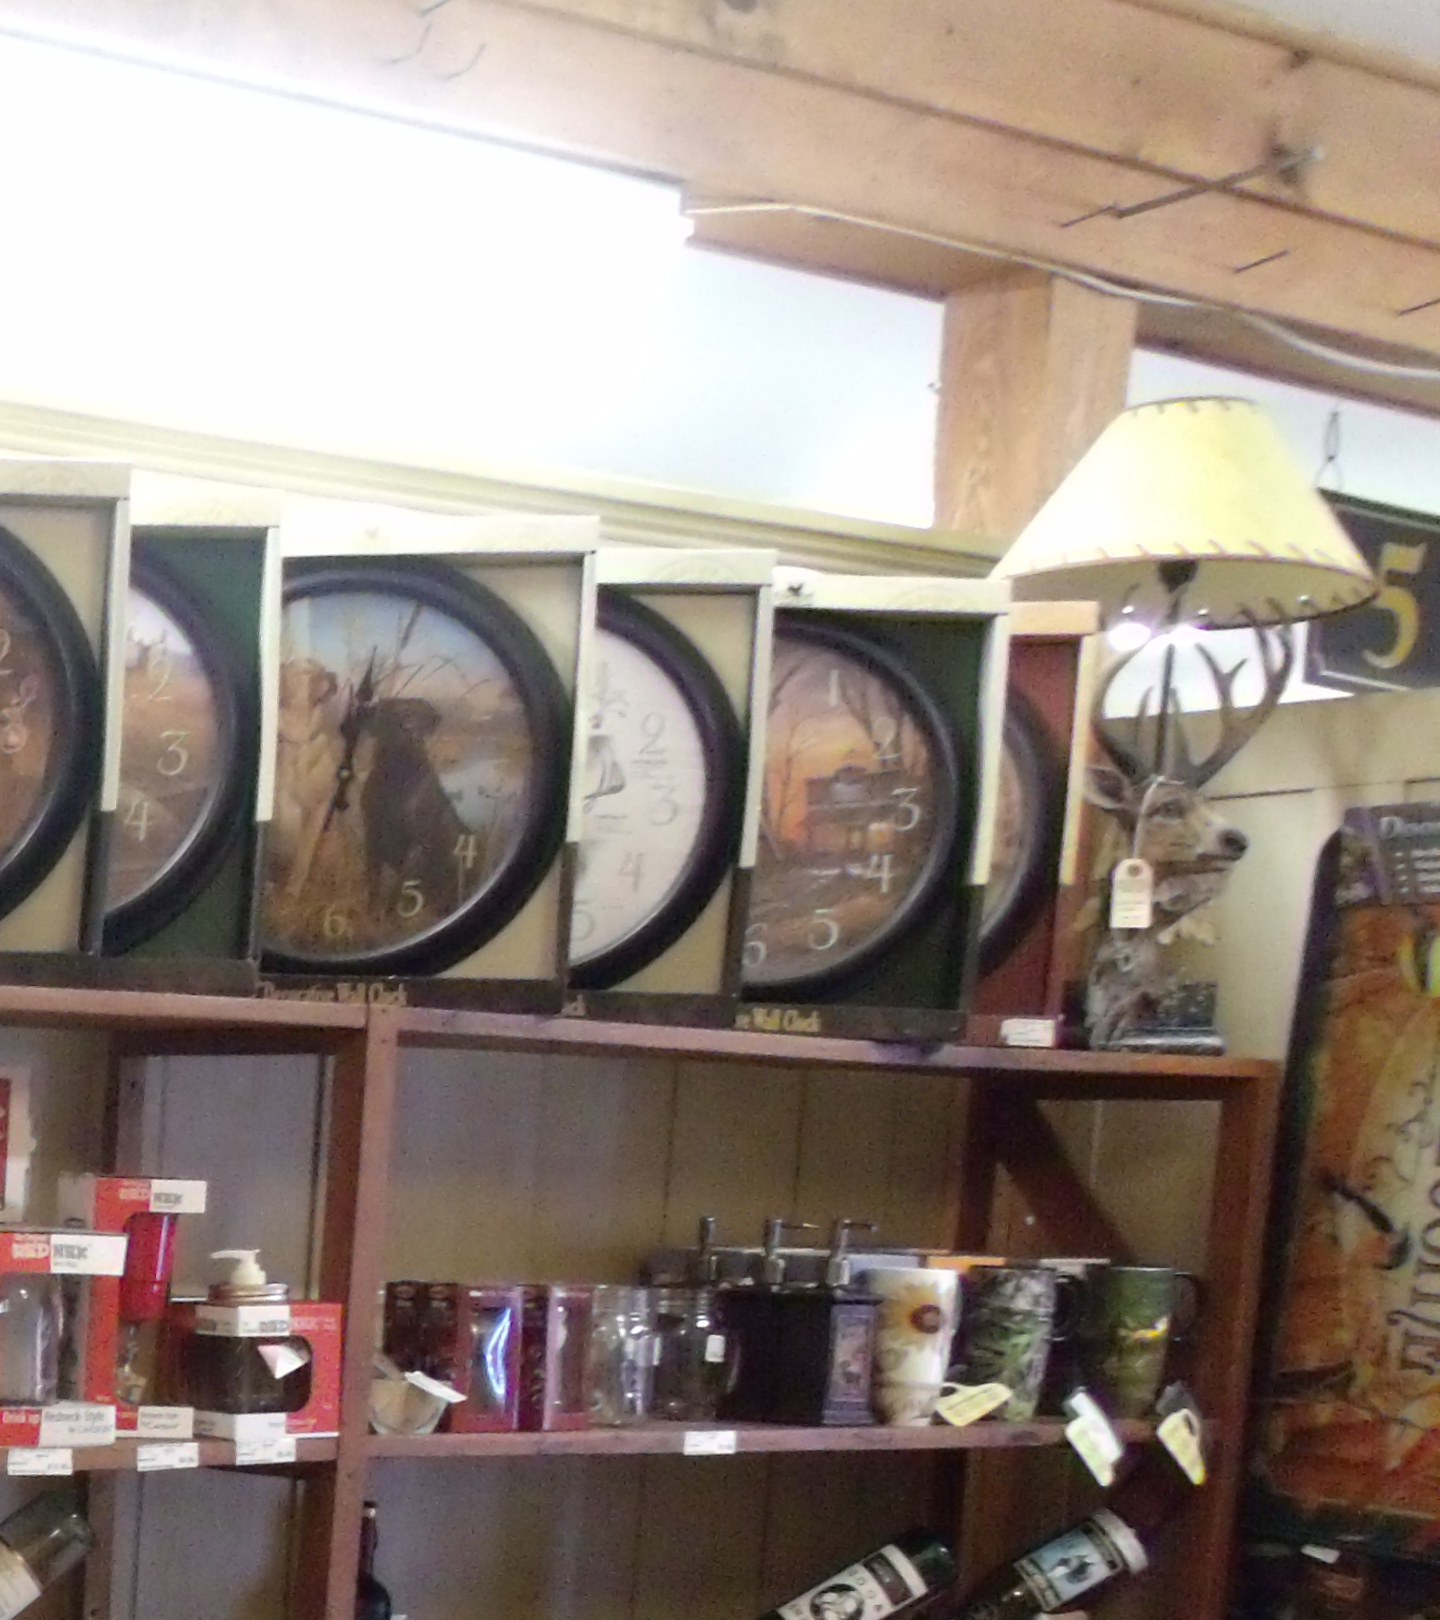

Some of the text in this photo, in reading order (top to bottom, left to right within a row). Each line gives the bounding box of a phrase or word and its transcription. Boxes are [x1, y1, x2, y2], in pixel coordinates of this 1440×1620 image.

[157, 730, 189, 776] 3
[124, 801, 154, 842] 4
[894, 789, 920, 832] 3
[453, 835, 478, 869] 4
[864, 854, 895, 894] 4
[397, 882, 424, 917] 5
[323, 906, 351, 937] 6
[807, 908, 839, 952] 5
[784, 1009, 822, 1032] Clock
